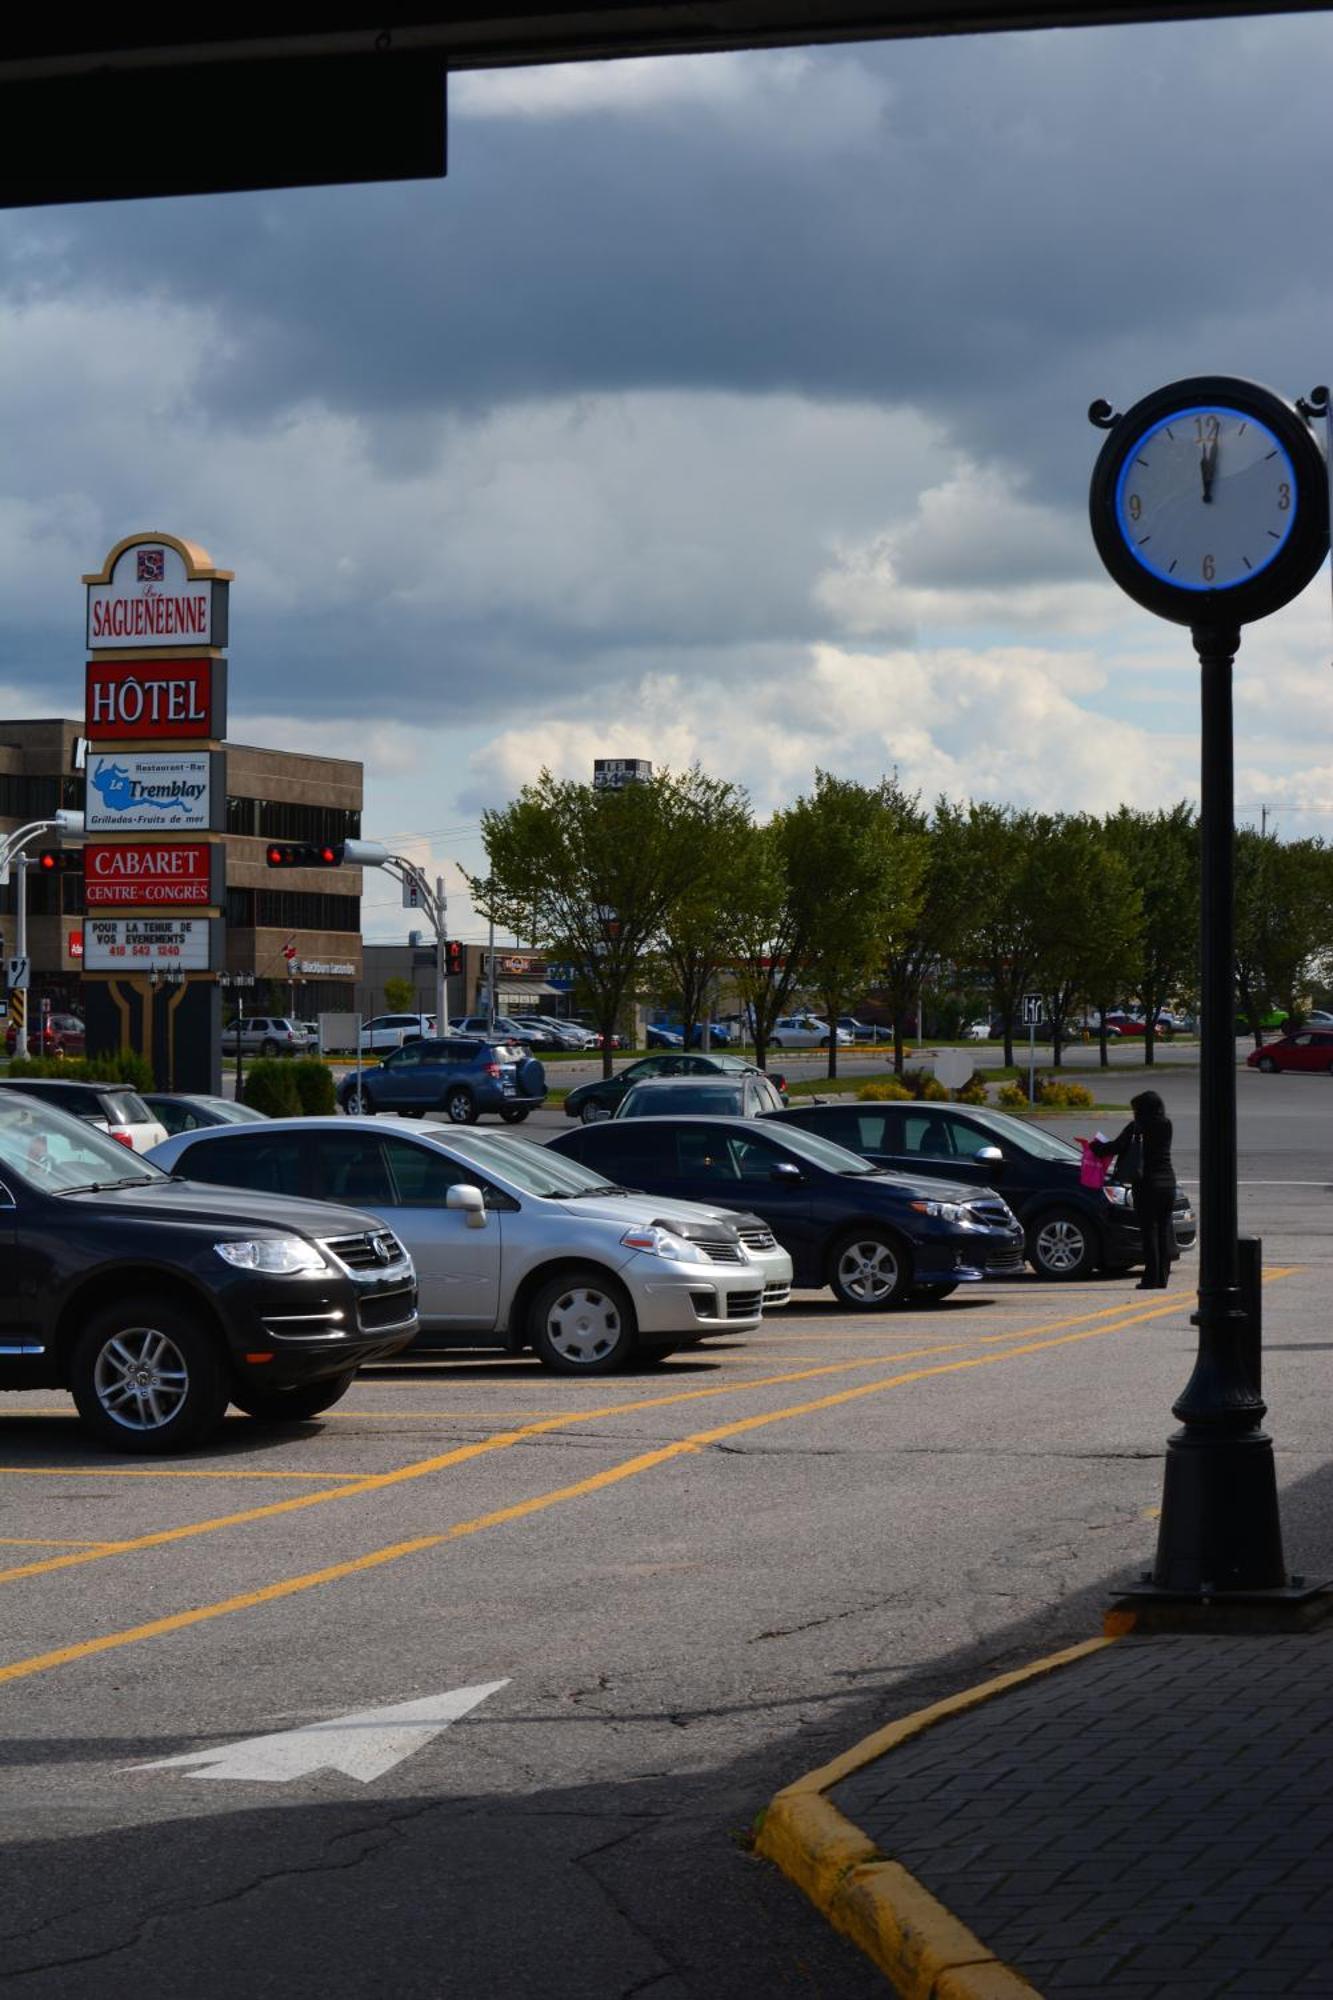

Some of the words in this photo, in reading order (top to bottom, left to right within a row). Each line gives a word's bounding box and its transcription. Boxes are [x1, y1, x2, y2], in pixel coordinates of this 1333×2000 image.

[1195, 415, 1217, 443] 12
[1130, 494, 1141, 520] 9
[1278, 483, 1289, 510] 3
[1202, 555, 1214, 581] 6
[93, 594, 206, 636] SAGUENÉENNE
[93, 676, 205, 721] HÔTEL
[129, 780, 205, 800] Tremblay
[170, 814, 181, 824] de
[186, 816, 204, 824] mer
[95, 851, 199, 875] CABARET
[87, 886, 137, 900] CENTRE
[145, 882, 208, 899] CONGRÈS
[92, 922, 117, 933] POUR
[126, 922, 138, 932] LA
[180, 922, 192, 932] DE
[97, 934, 116, 945] VOS
